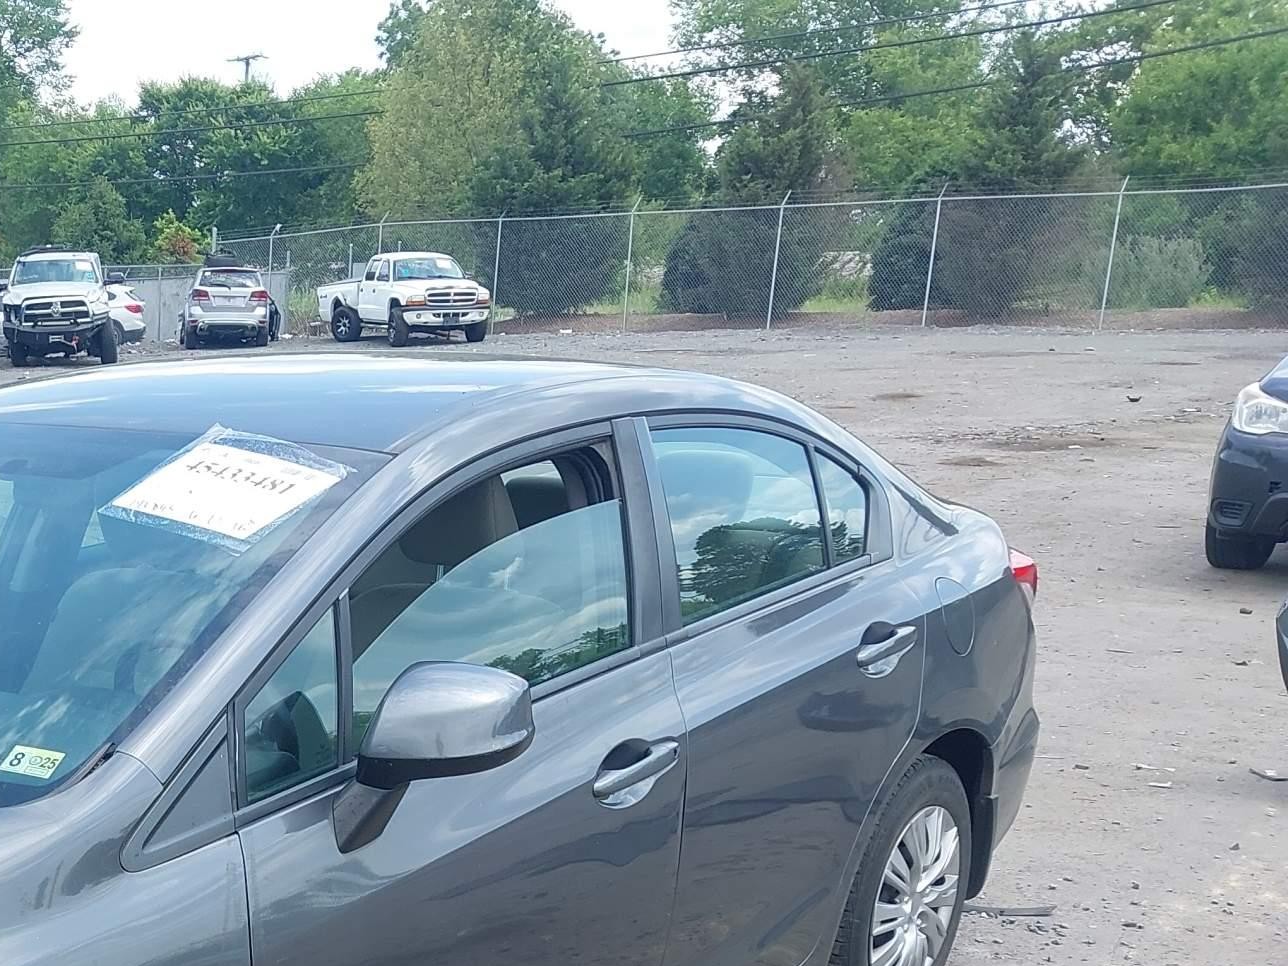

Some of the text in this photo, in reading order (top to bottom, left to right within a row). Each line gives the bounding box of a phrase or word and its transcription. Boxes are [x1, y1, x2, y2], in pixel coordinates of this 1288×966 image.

[186, 460, 296, 494] 45433481
[9, 752, 59, 769] 8 25
